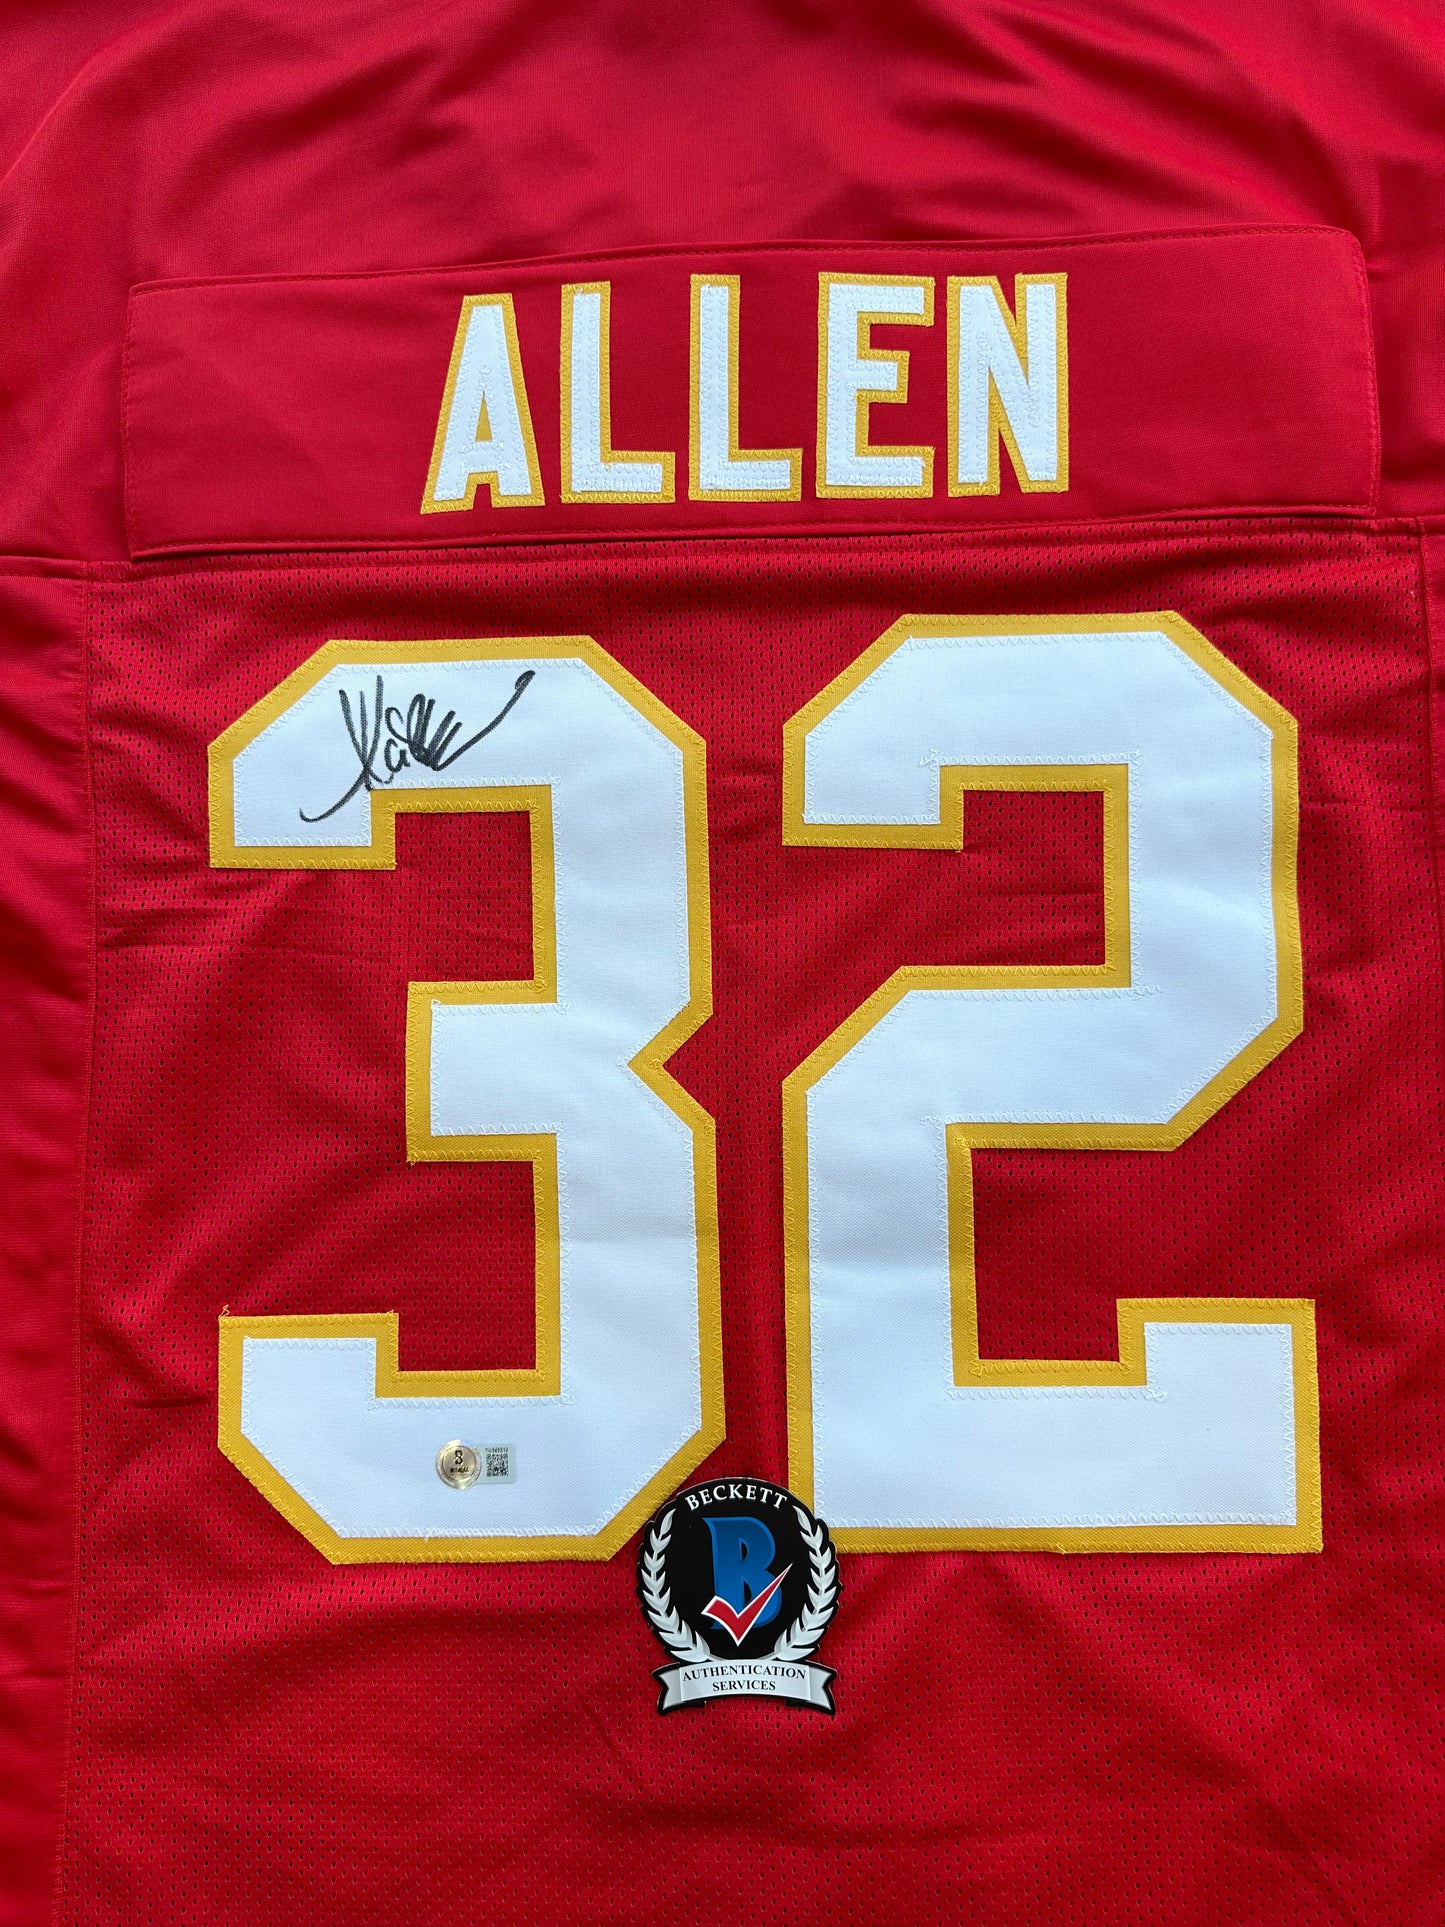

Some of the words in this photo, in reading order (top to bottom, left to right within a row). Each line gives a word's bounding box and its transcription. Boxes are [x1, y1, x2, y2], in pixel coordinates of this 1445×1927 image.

[420, 272, 1069, 514] ALLEN
[208, 610, 1323, 1566] 32
[684, 1483, 788, 1511] BECKETT
[702, 1516, 783, 1630] B
[682, 1664, 807, 1682] AUTHENTICATION
[712, 1679, 776, 1692] SERVICES
